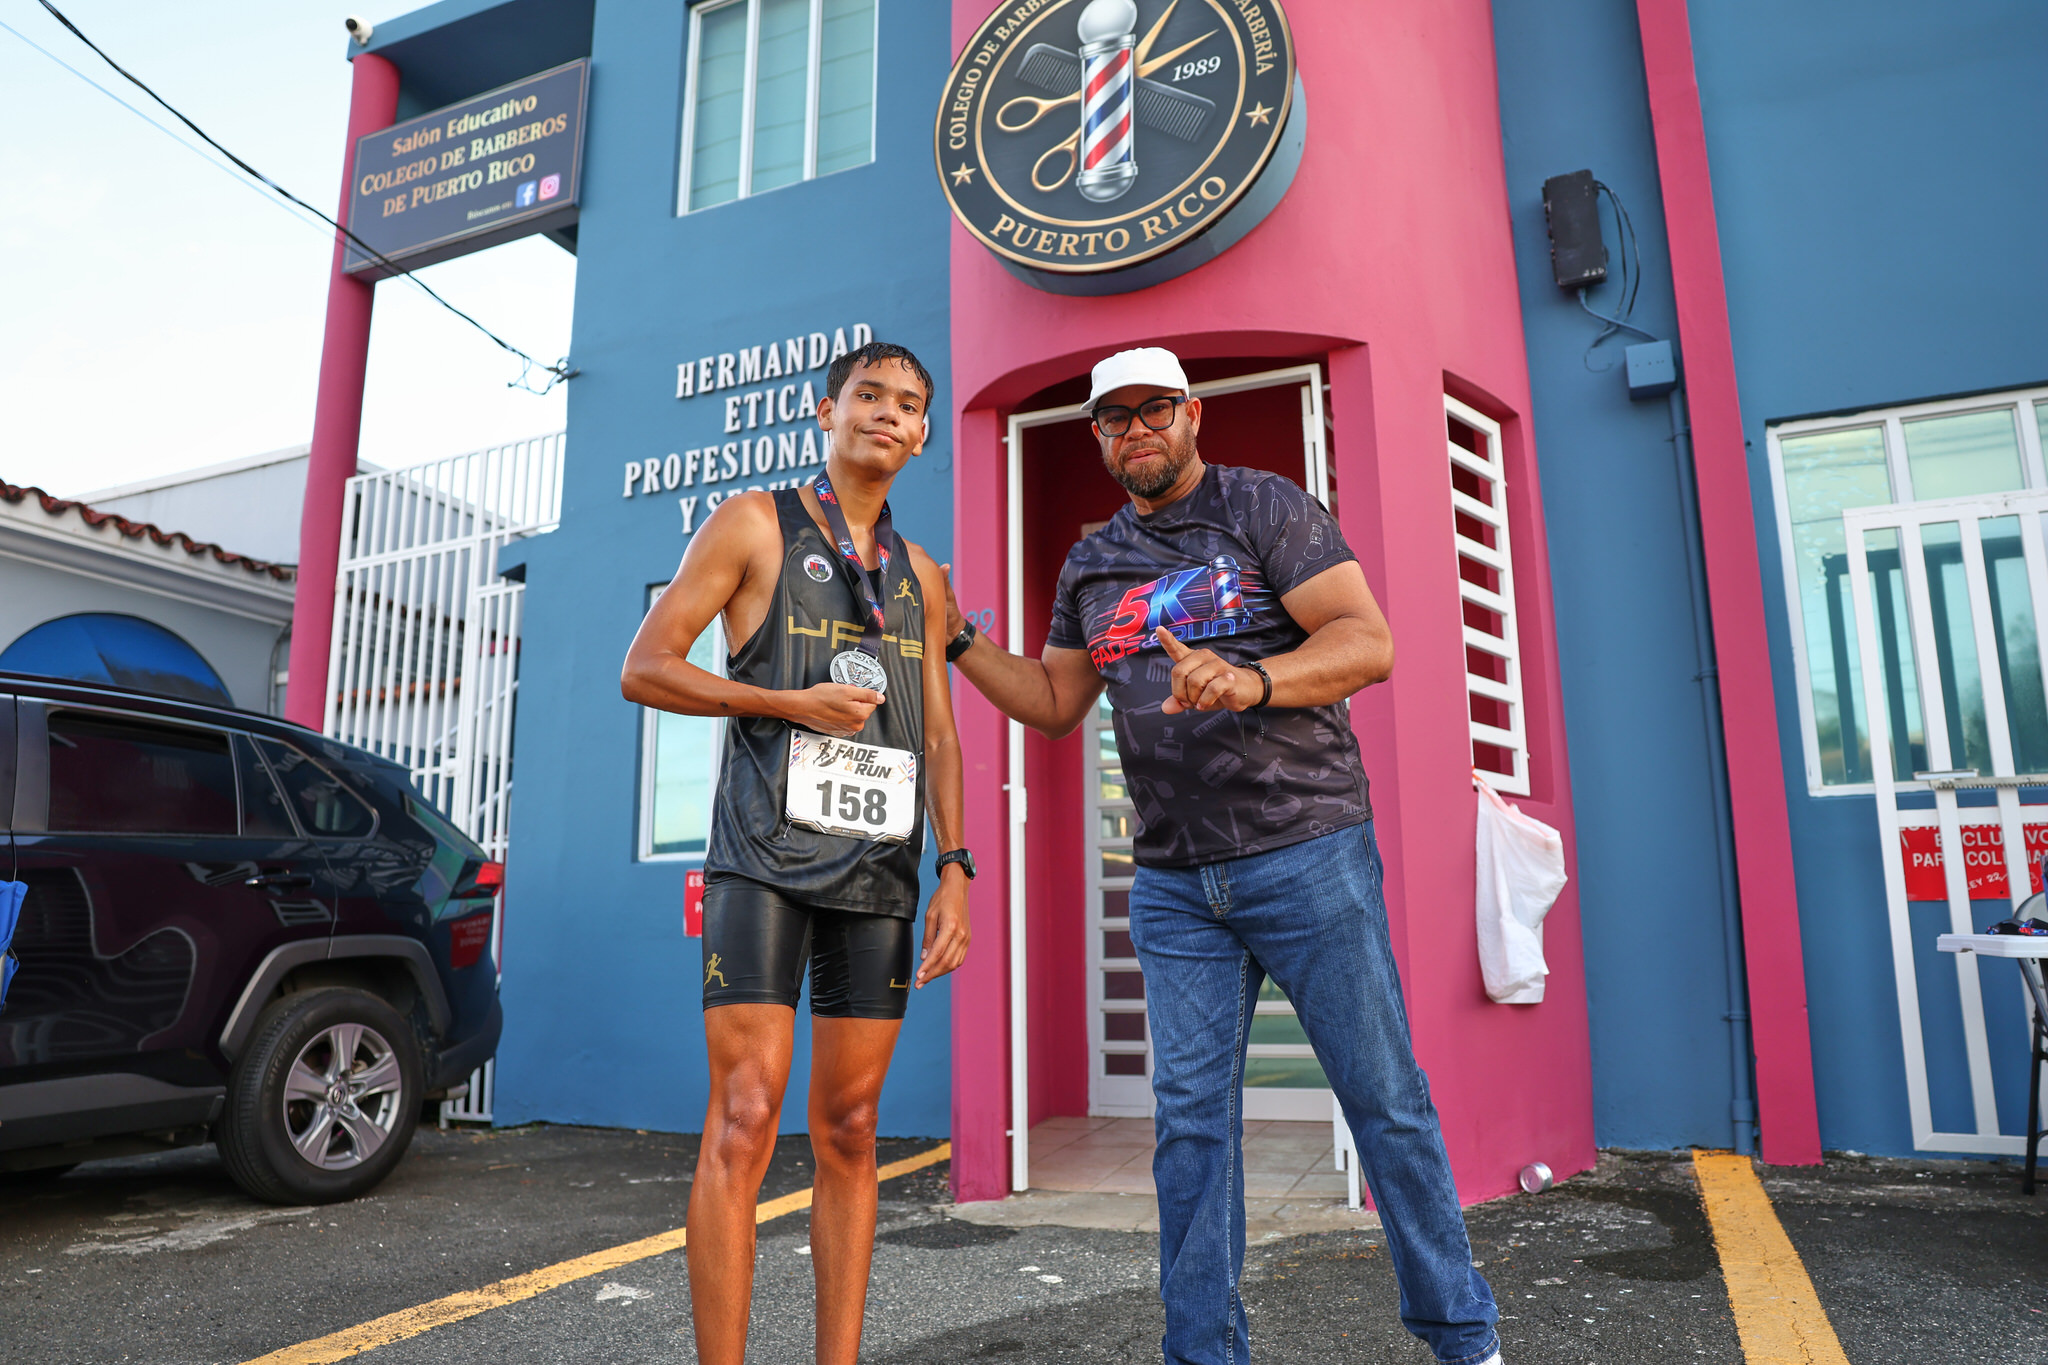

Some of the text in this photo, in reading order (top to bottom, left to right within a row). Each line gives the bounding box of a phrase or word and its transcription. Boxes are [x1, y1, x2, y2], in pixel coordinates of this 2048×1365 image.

[949, 0, 1278, 150] COLEGIO DE BARB ARBERÍA
[1172, 55, 1221, 82] 1989
[360, 112, 568, 197] COLEGIO DE BARBEROS
[391, 94, 538, 158] Salón Educativo
[382, 152, 536, 218] DE PUERTO RICO
[989, 175, 1228, 257] PUERTO RICO
[675, 323, 873, 399] HERMANDAD
[724, 380, 817, 434] ETICA
[678, 495, 698, 535] Y
[1106, 565, 1209, 640] 5K
[1090, 634, 1147, 672] FADE
[833, 743, 880, 764] FADE
[844, 760, 855, 772] &
[854, 762, 893, 780] RUN
[816, 779, 888, 826] 158
